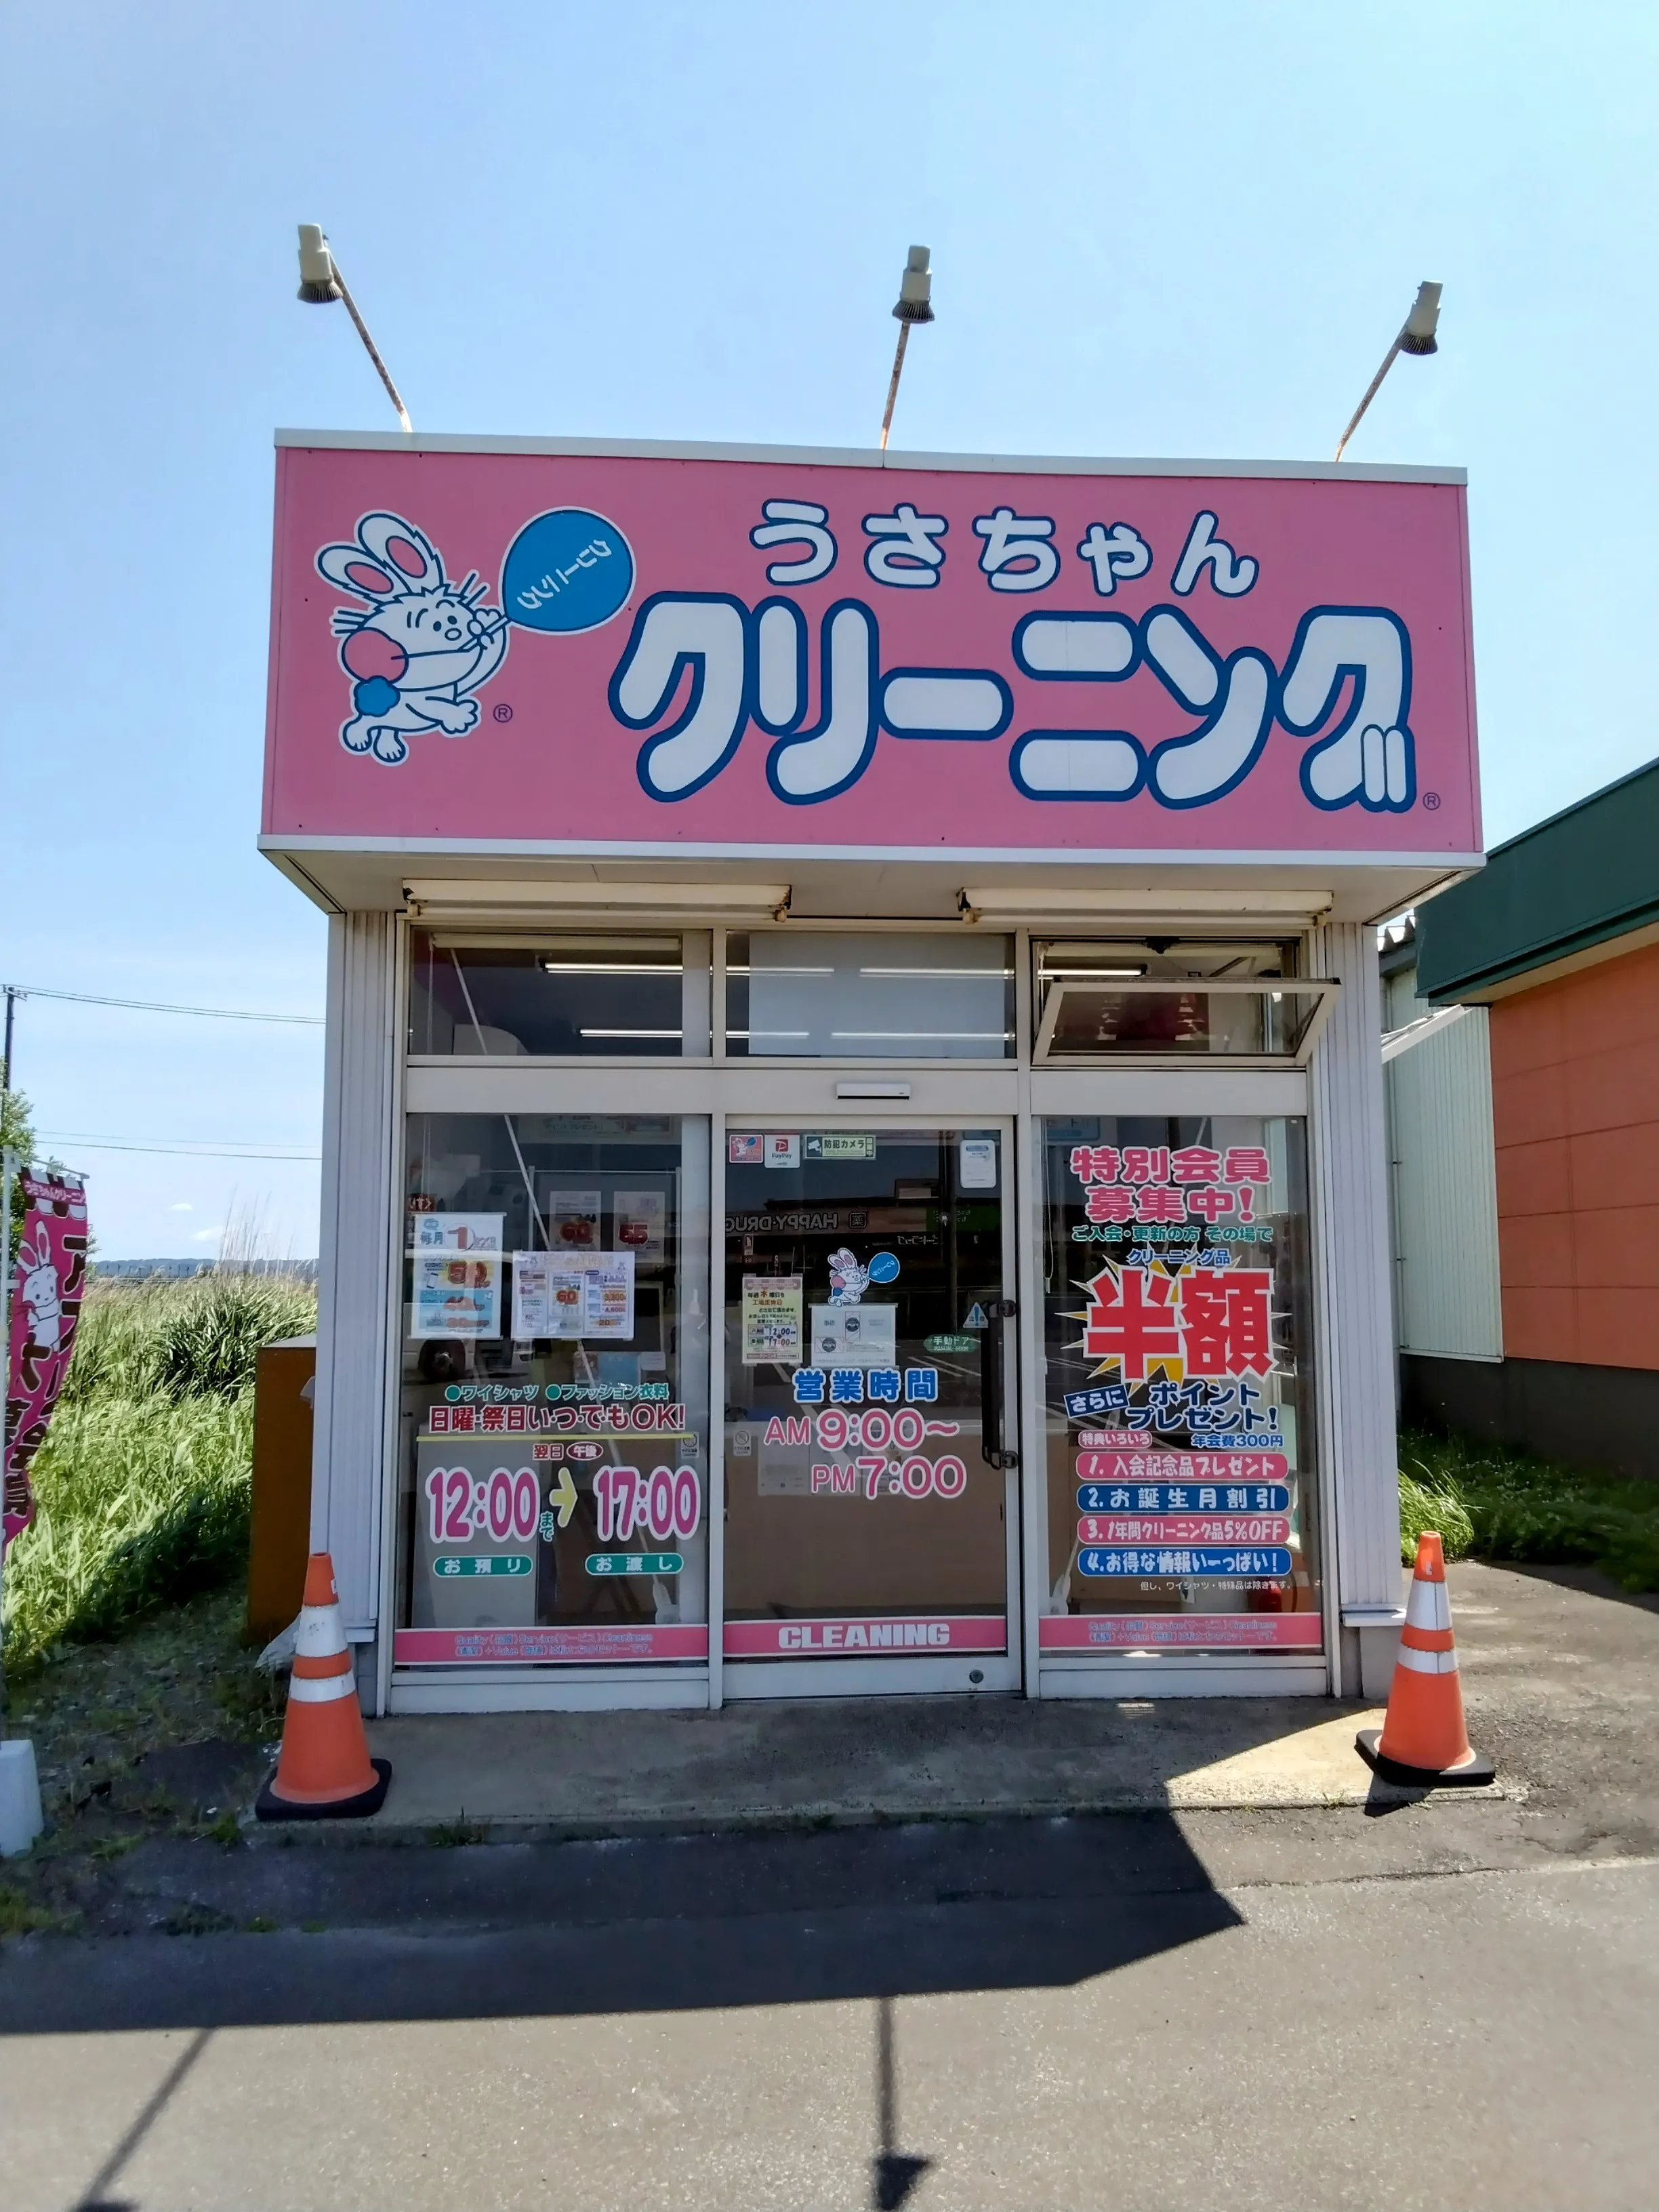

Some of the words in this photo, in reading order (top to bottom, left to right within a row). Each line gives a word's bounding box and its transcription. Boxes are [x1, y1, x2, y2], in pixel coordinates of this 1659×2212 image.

[750, 498, 1259, 597] うさちゃん
[607, 590, 1417, 813] クリーニング
[823, 1139, 865, 1149] 防犯カメラ
[1070, 1145, 1271, 1184] 特別会員
[1086, 1185, 1256, 1224] 募集中!
[1071, 1225, 1200, 1242] ご入会・更新の方
[1204, 1225, 1274, 1242] その場で
[1126, 1248, 1231, 1266] クリーニング品
[1083, 1265, 1279, 1384] 半額
[933, 1336, 970, 1345] 手動ドア
[792, 1367, 938, 1404] 営業時間
[1149, 1382, 1261, 1407] ポイント
[1070, 1388, 1125, 1414] さらに
[764, 1416, 811, 1446] AM
[1125, 1407, 1280, 1433] プレゼント!
[533, 1443, 565, 1460] 翌日
[572, 1445, 598, 1458] 午後
[1082, 1433, 1151, 1446] 特典いろいろ
[1191, 1433, 1284, 1448] 年会費300円
[811, 1464, 855, 1493] PM
[855, 1454, 967, 1500] 7:00
[426, 1467, 540, 1542] 12:00
[593, 1465, 701, 1542] 17:00
[539, 1511, 555, 1542] まで
[443, 1558, 521, 1575] お預り
[595, 1556, 673, 1572] お渡し
[778, 1623, 950, 1649] CLEANING
